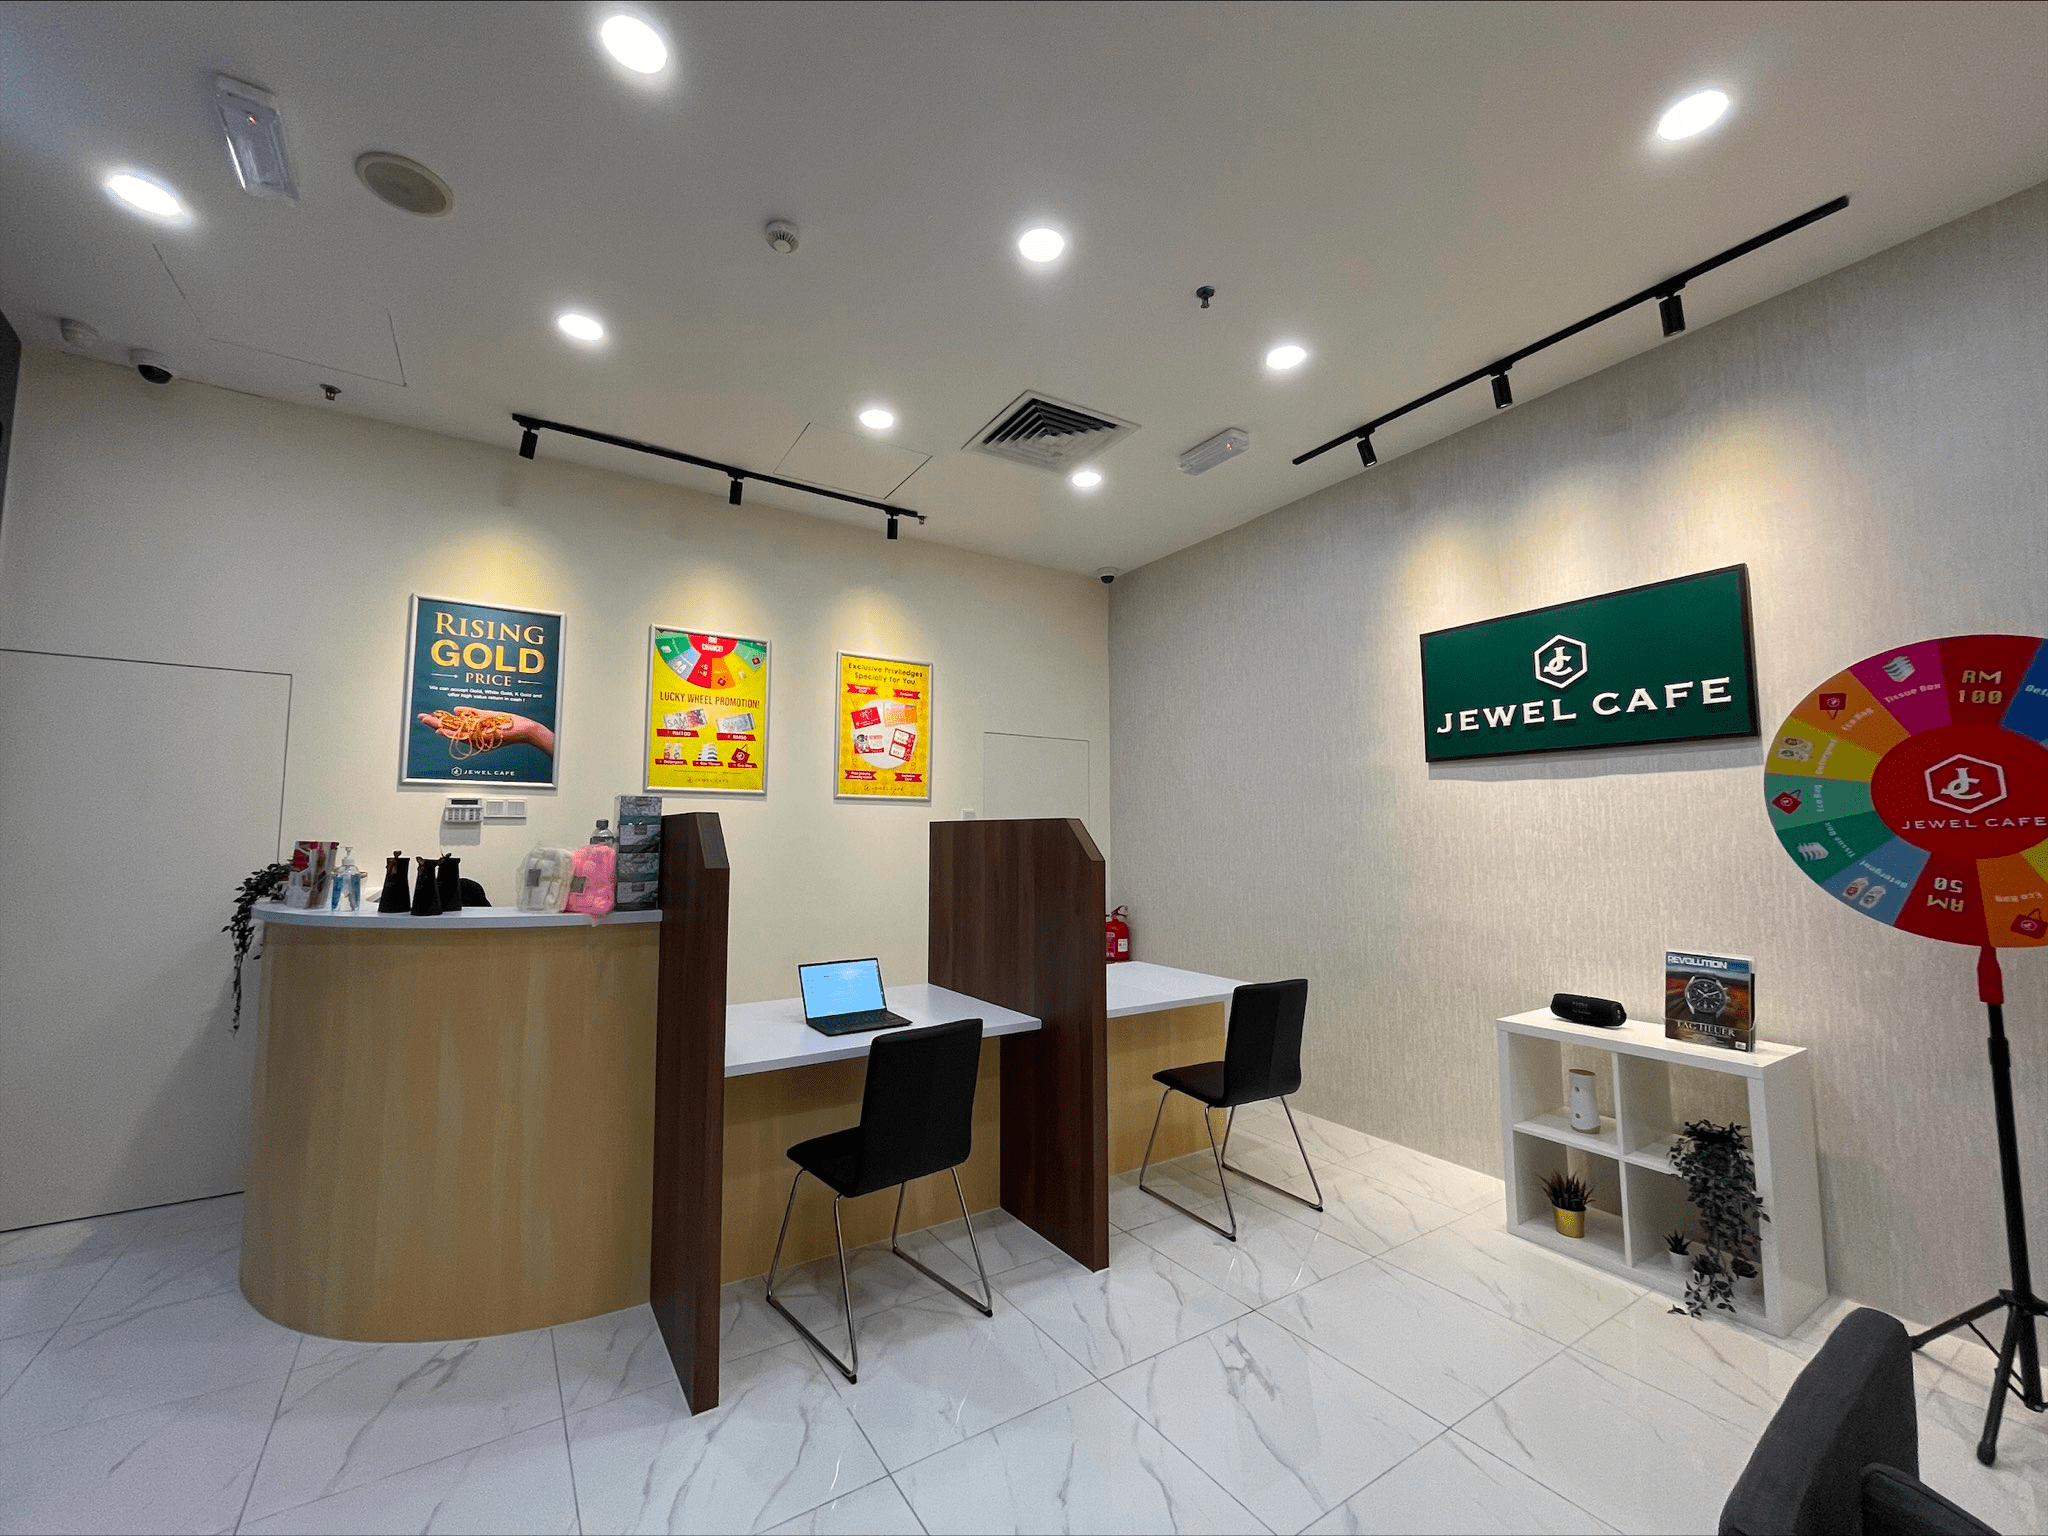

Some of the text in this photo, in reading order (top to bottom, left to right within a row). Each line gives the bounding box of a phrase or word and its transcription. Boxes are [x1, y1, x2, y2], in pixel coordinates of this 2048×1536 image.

[434, 612, 545, 645] RISING
[430, 638, 545, 674] GOLD
[848, 662, 882, 673] Exclusive
[465, 672, 512, 686] PRICE
[854, 672, 887, 683] Specially
[1962, 670, 2002, 684] RM
[660, 691, 760, 709] LUCKY WHEEL PROMOTION!
[1883, 682, 1942, 703] Tissue Box
[1958, 689, 2003, 704] 100
[1436, 676, 1732, 734] JEWEL CAFE
[1902, 816, 2048, 830] JEWEL CAFE
[1858, 860, 1908, 888] Detergent
[1934, 877, 1963, 893] 50
[1926, 894, 1964, 912] RM
[1667, 955, 1728, 970] REVOLUTION
